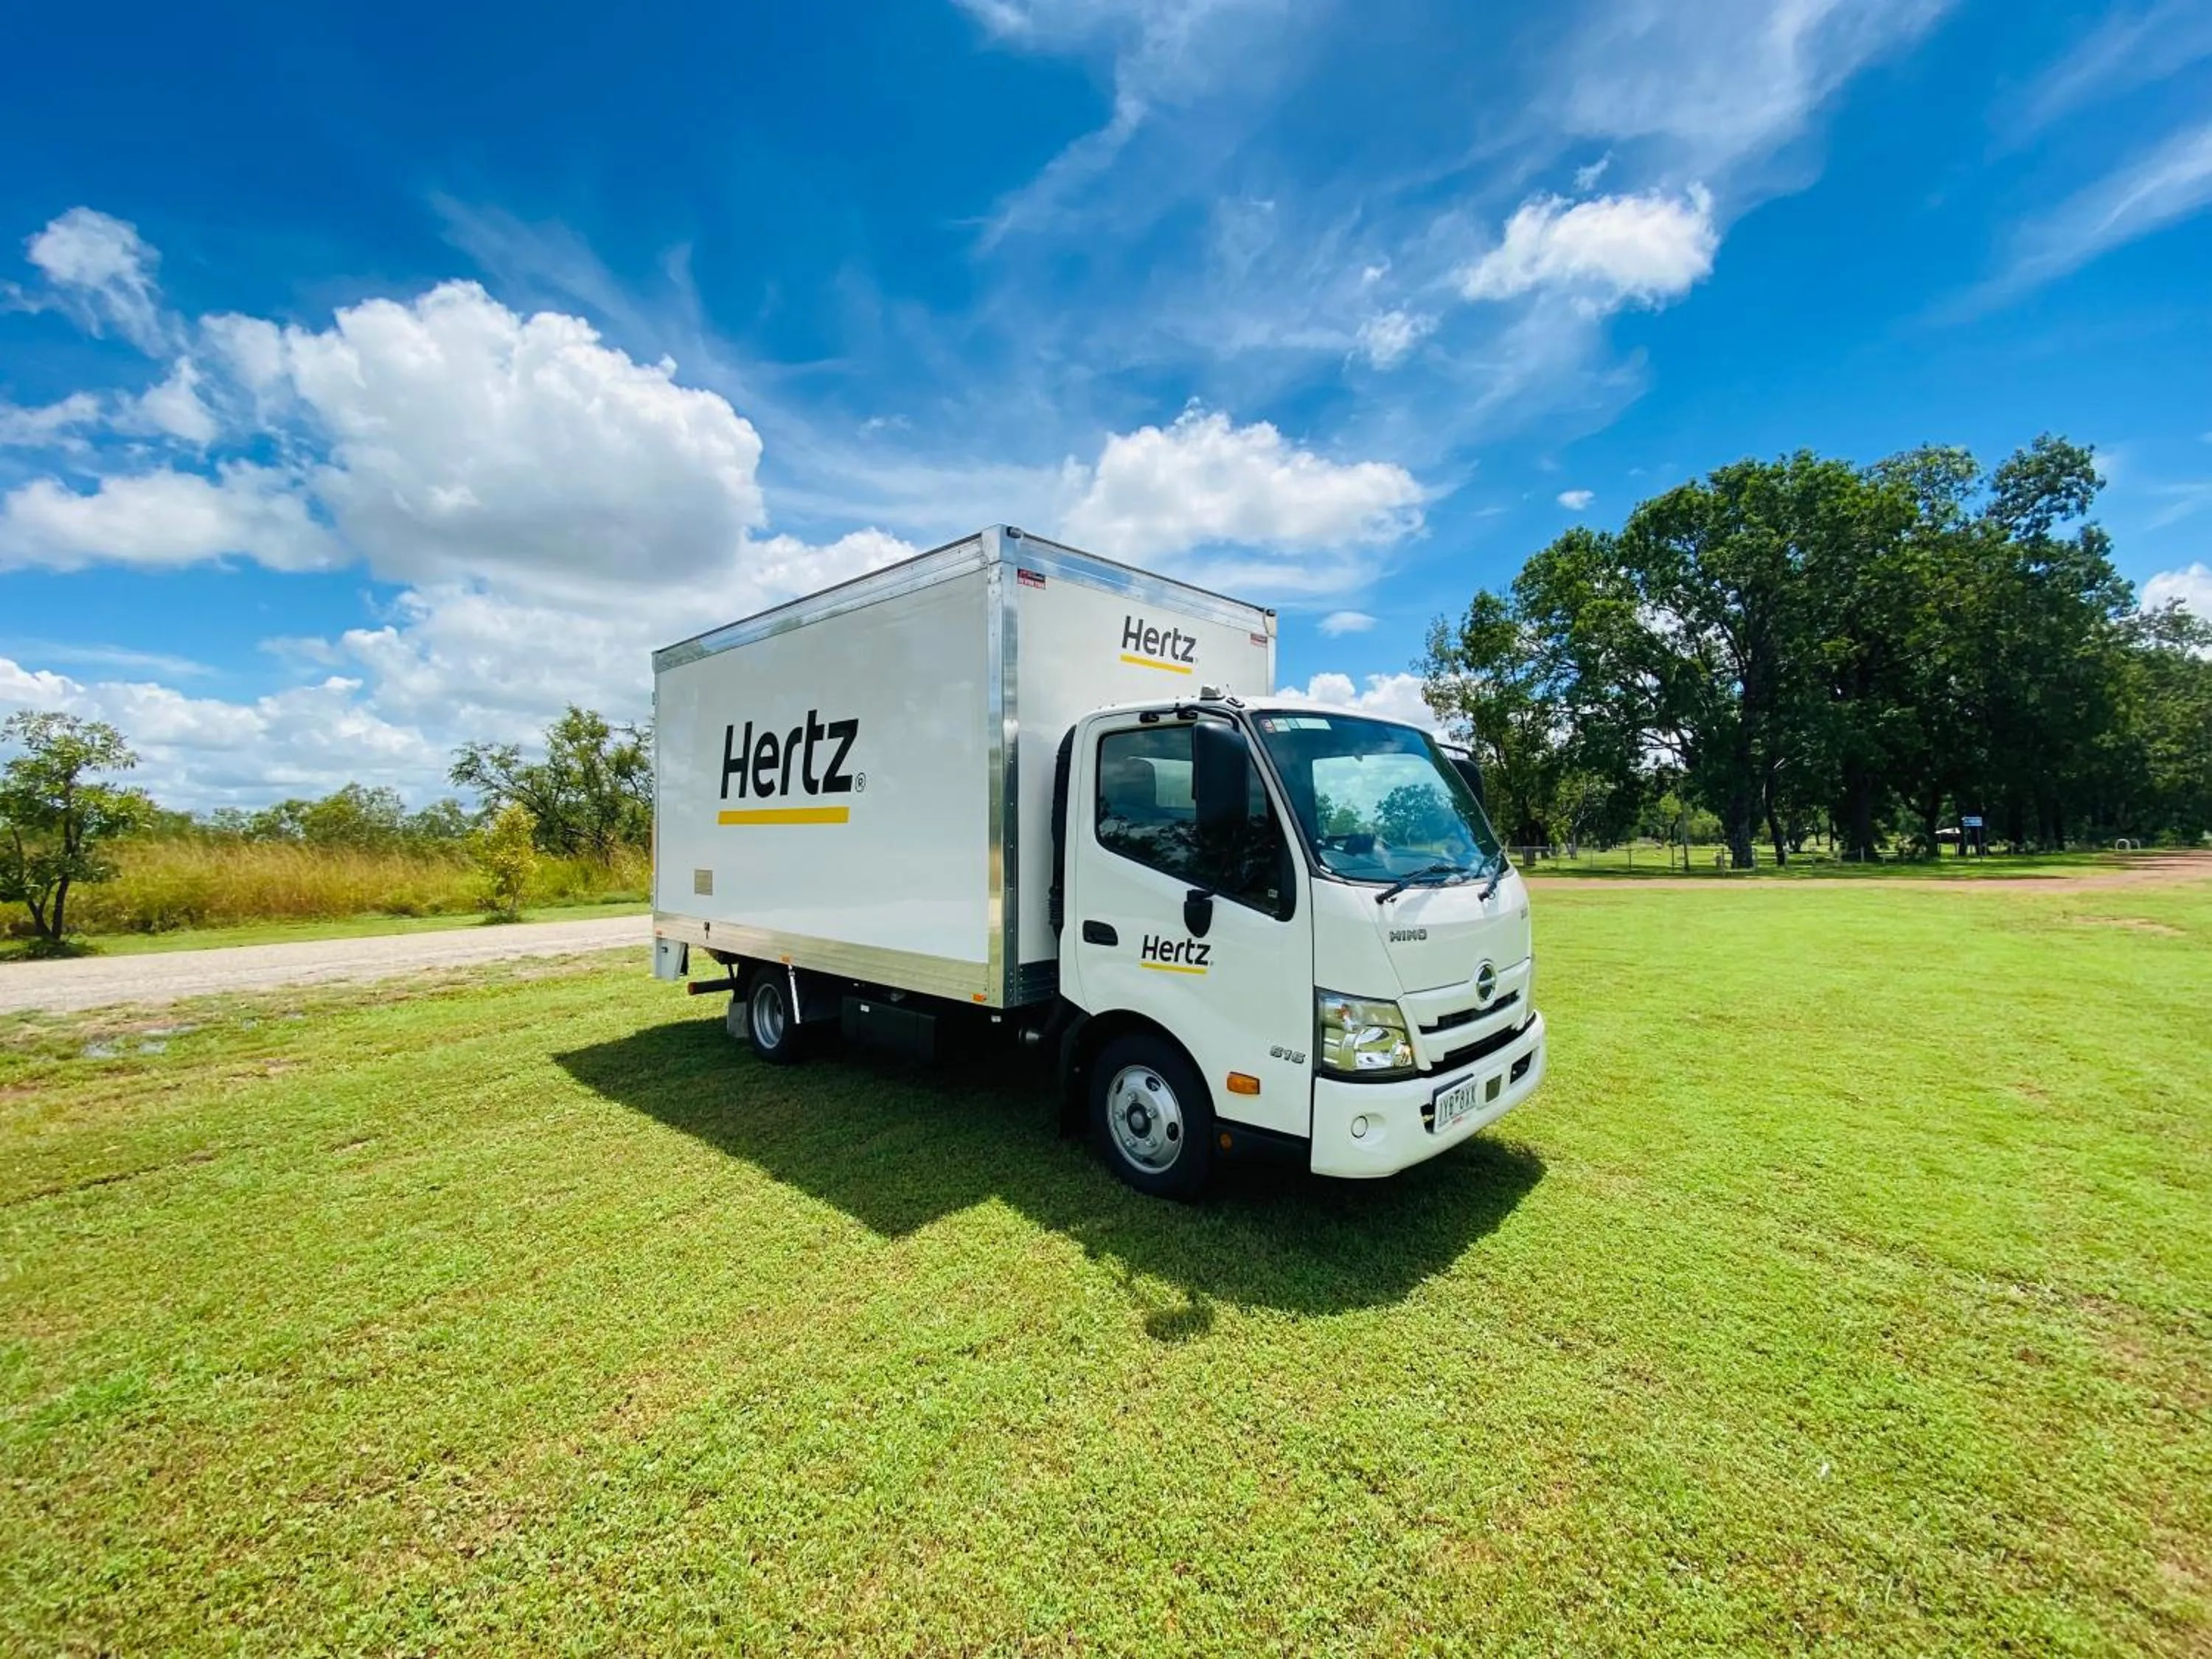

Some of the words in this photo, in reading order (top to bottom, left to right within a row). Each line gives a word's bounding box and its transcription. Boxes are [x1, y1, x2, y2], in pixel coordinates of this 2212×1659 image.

[1121, 616, 1196, 662] Hertz
[720, 709, 858, 799] Hertz
[1141, 934, 1211, 966] Hertz
[1389, 929, 1427, 942] HINO
